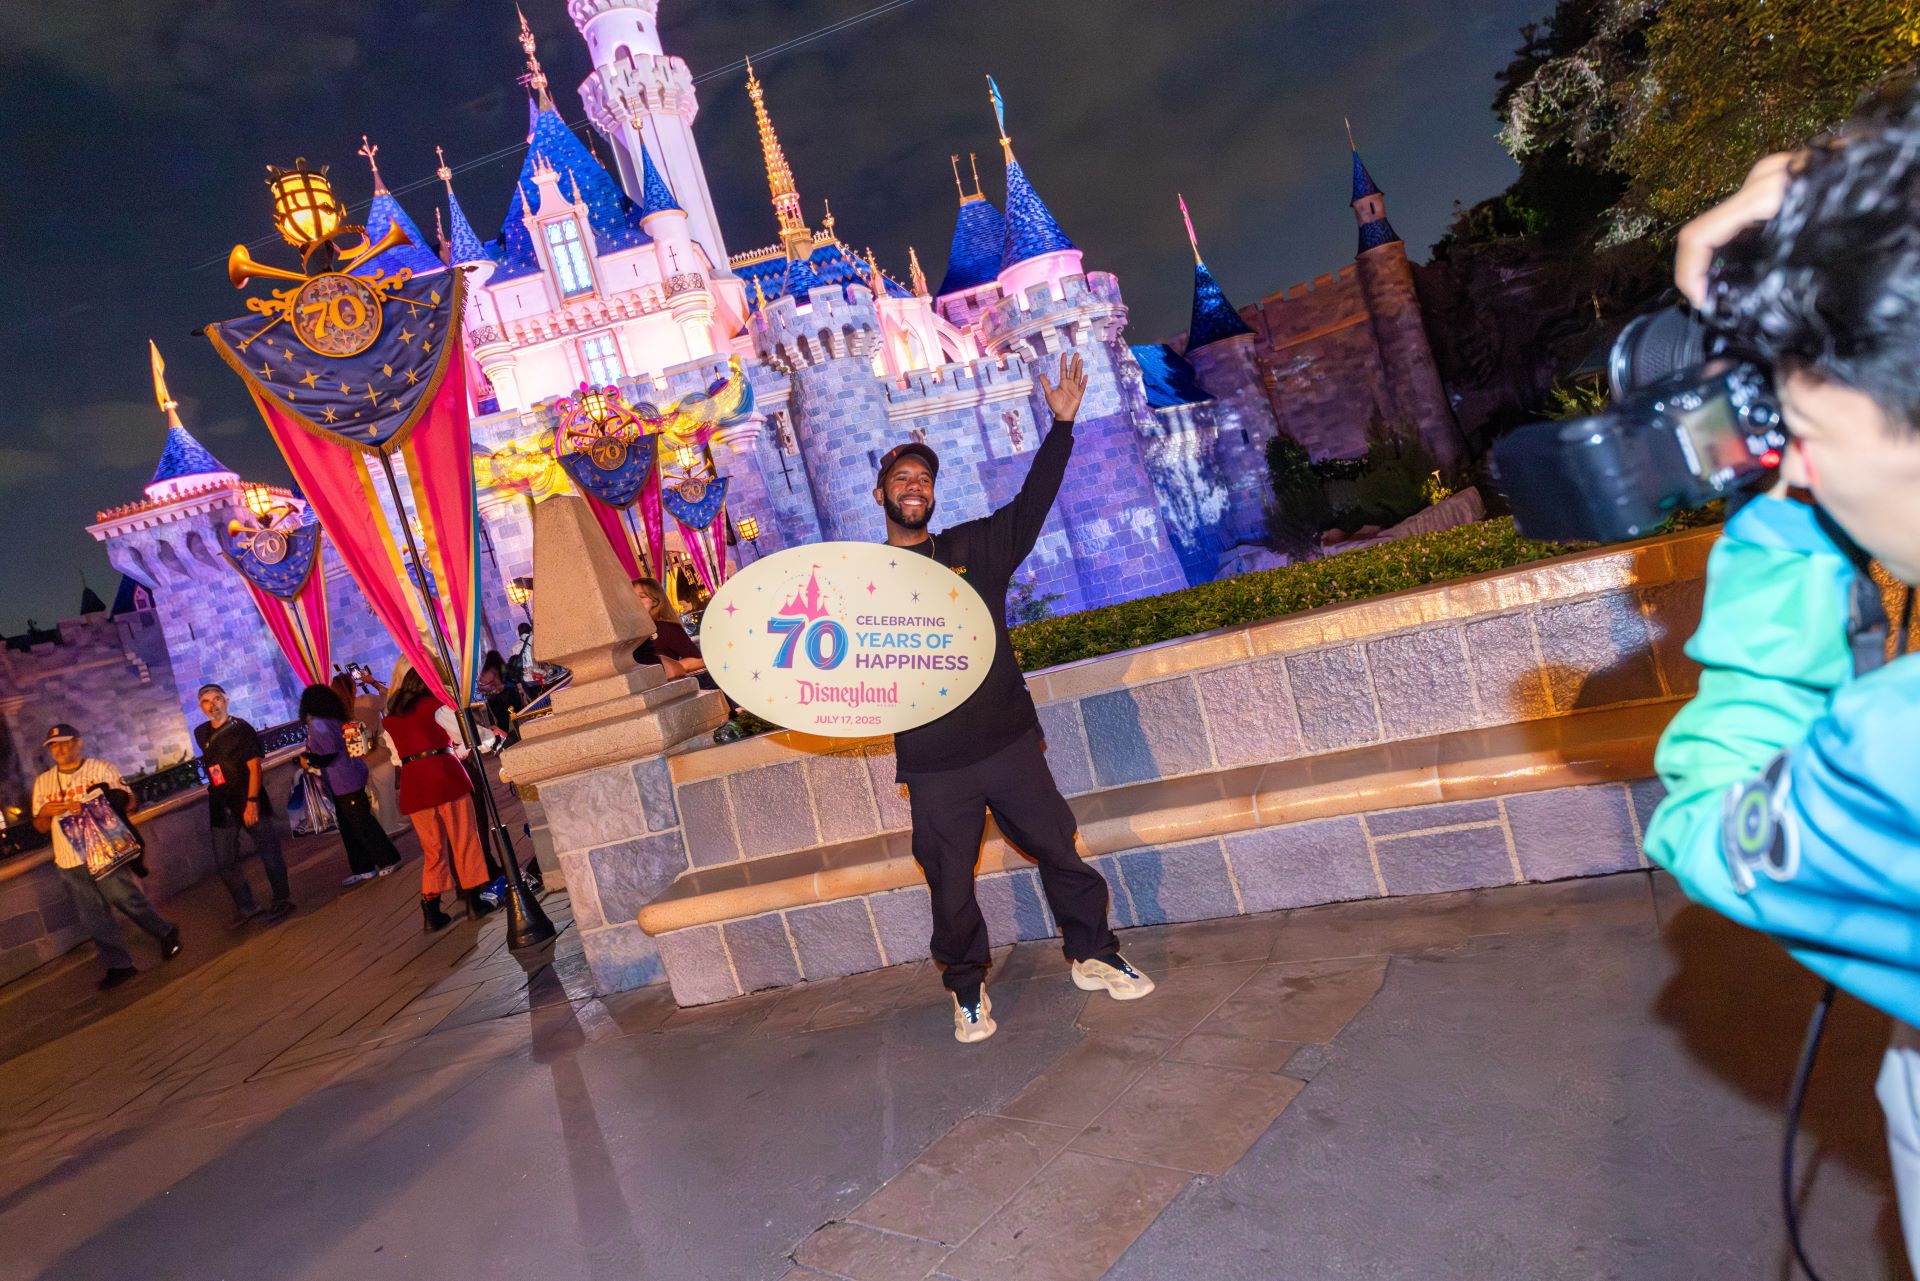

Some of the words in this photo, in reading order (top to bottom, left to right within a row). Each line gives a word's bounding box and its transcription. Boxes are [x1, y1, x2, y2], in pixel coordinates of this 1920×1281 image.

[303, 294, 367, 339] 70
[595, 444, 621, 463] 70
[256, 537, 281, 558] 70
[856, 615, 946, 628] CELEBRATING
[767, 616, 849, 671] 70
[856, 632, 922, 649] YEARS
[926, 633, 954, 649] OF
[856, 653, 969, 671] HAPPINESS
[796, 679, 898, 708] Disneyland
[814, 715, 840, 724] JULY
[841, 715, 853, 725] 17,
[855, 716, 882, 725] 2025
